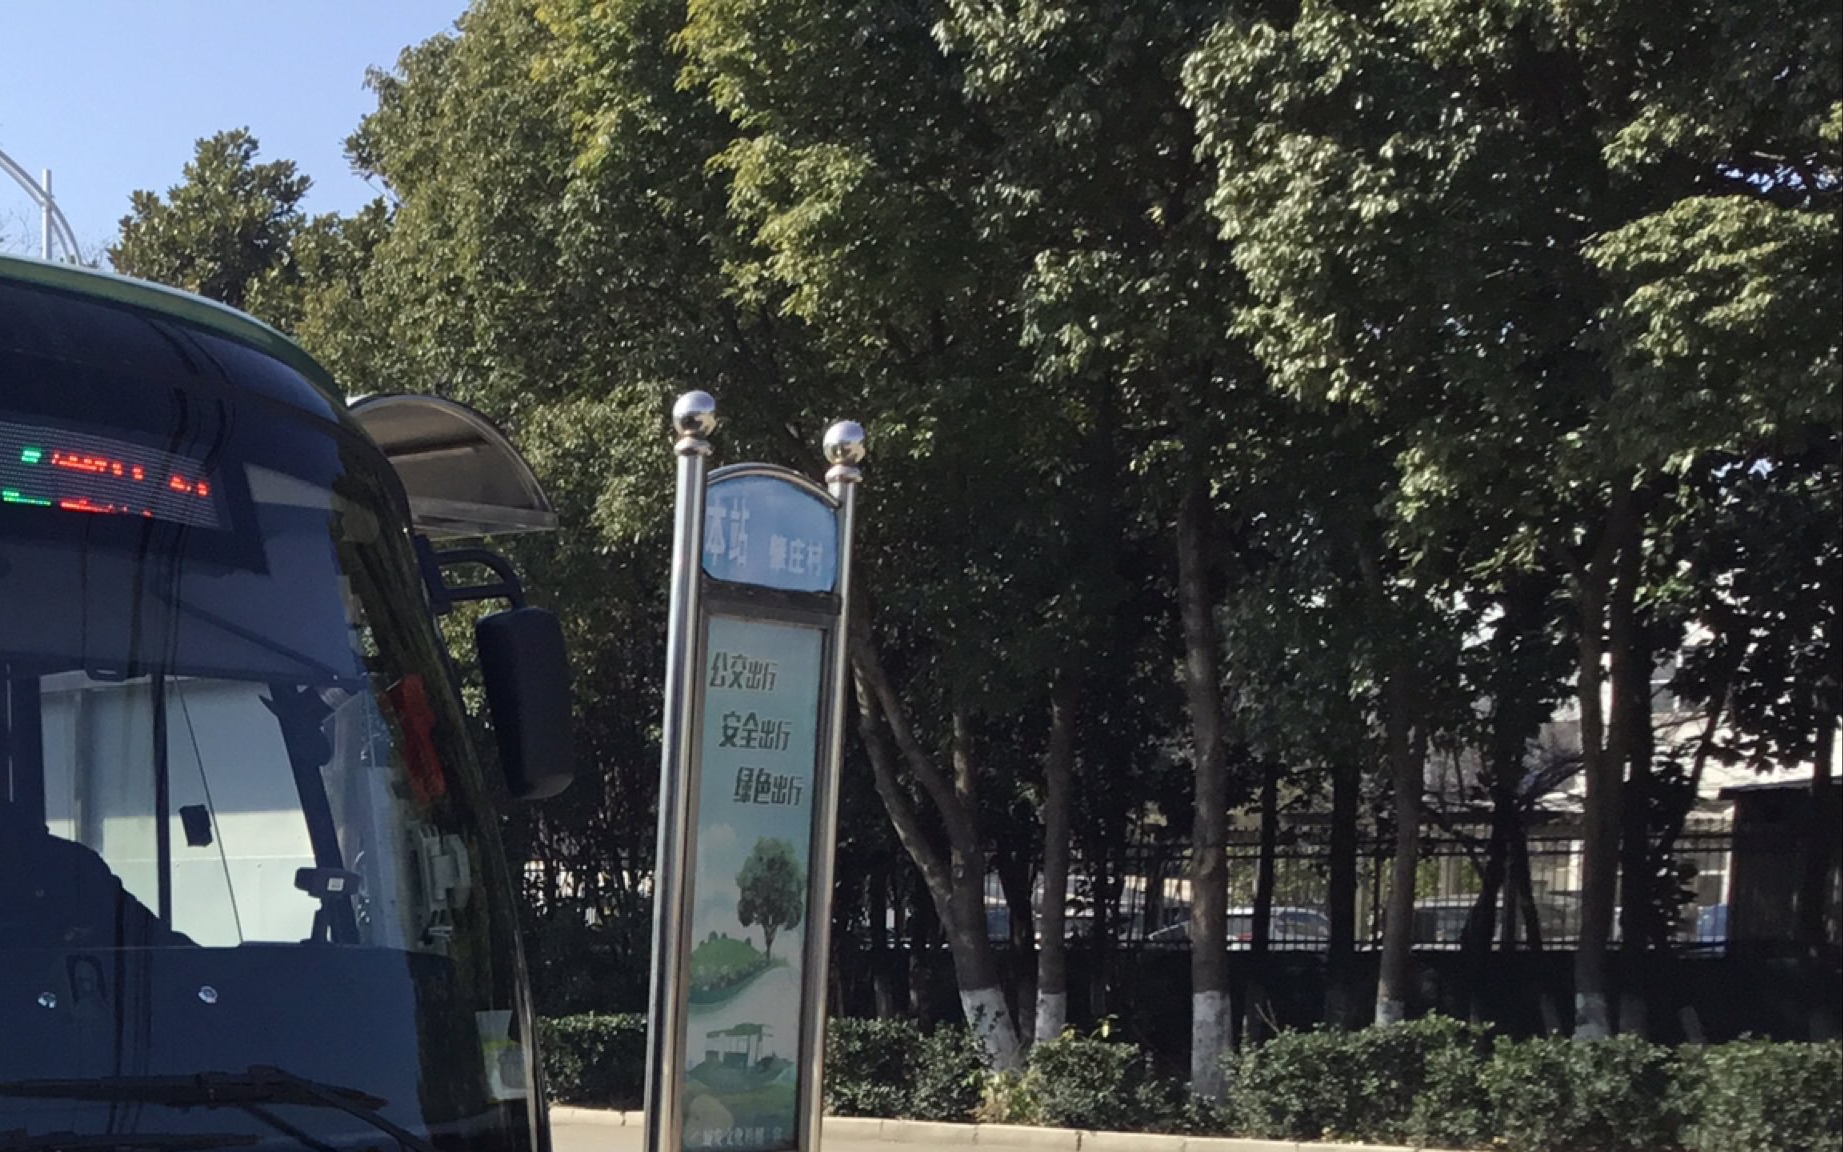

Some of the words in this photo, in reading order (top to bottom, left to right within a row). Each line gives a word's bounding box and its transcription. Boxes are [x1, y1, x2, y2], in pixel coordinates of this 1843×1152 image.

[709, 651, 779, 691] 公交出行
[718, 710, 793, 751] 安全出行
[732, 765, 804, 806] 绿色出行
